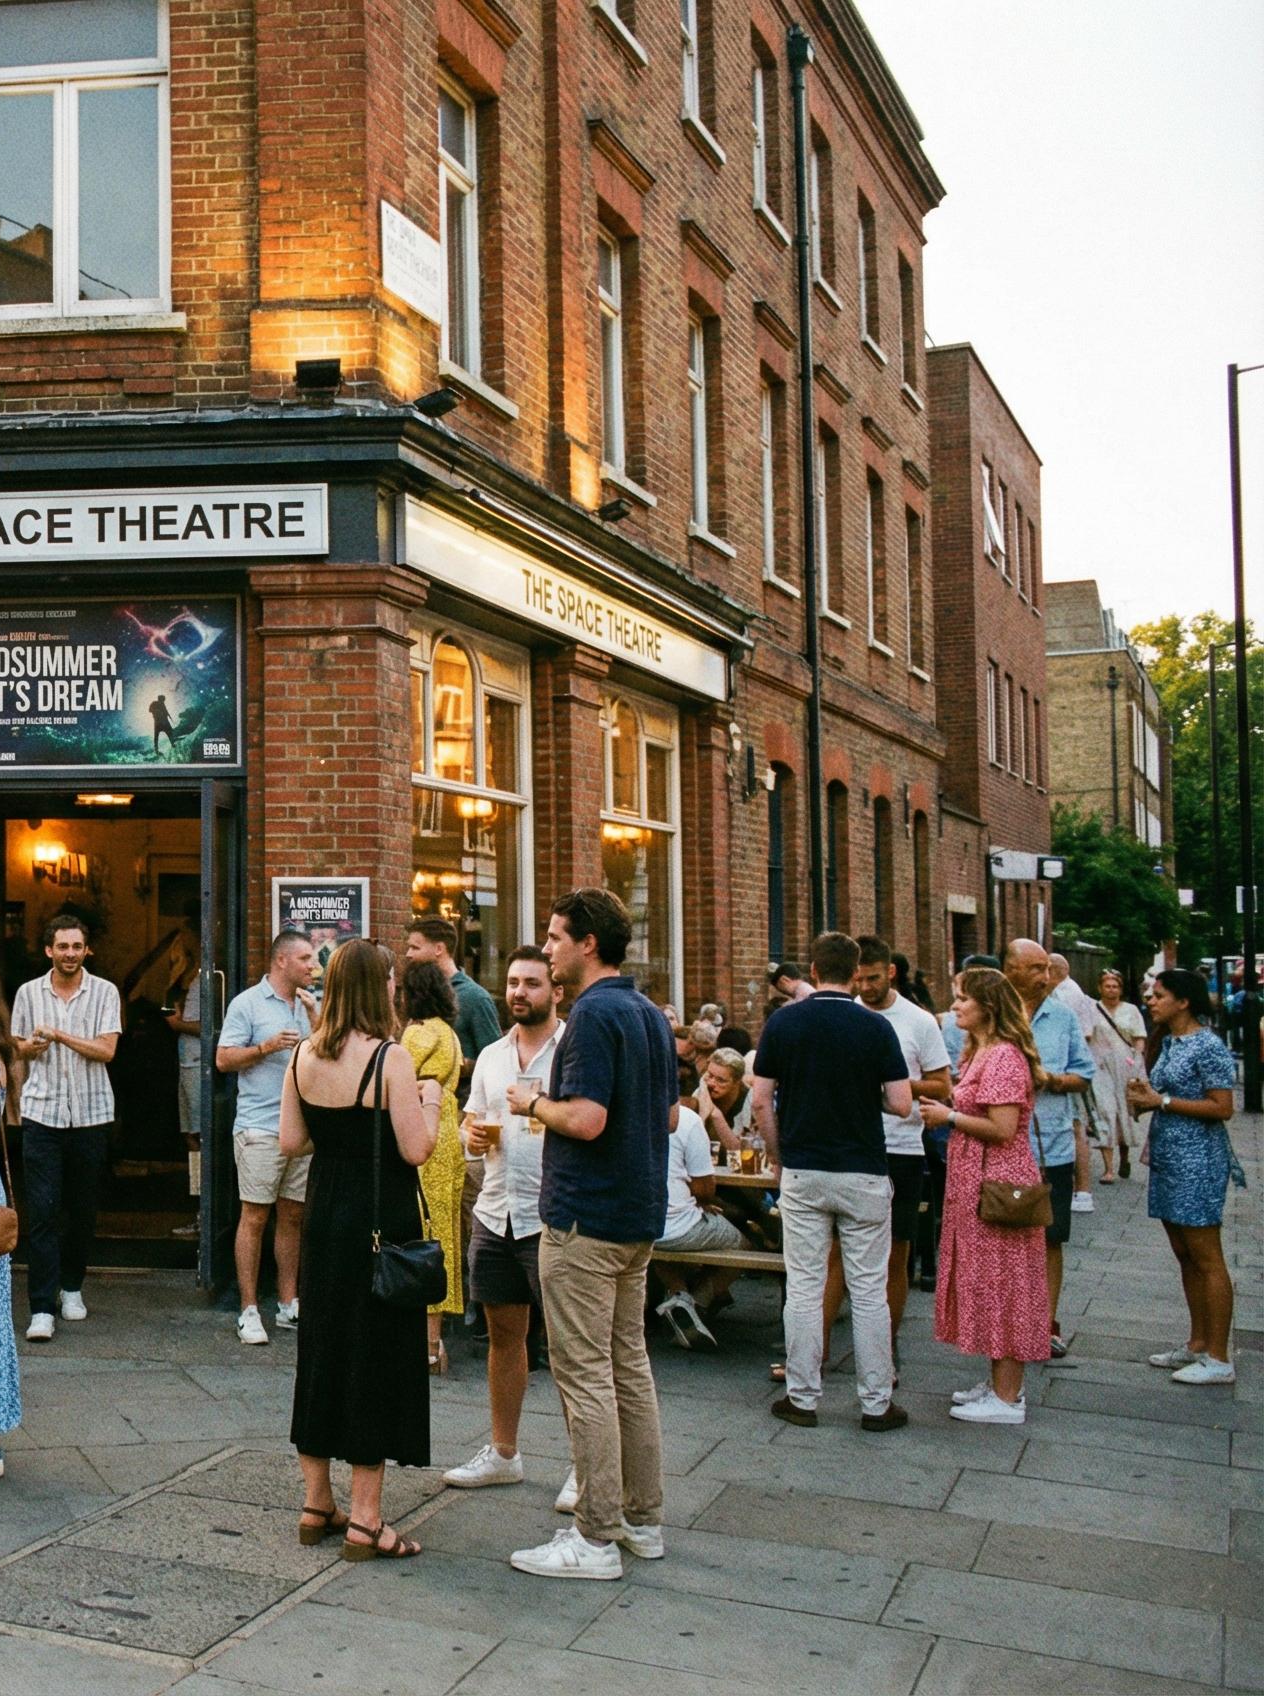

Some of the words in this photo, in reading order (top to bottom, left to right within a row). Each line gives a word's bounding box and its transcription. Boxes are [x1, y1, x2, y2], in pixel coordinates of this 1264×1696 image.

[88, 501, 305, 543] THEATRE
[522, 568, 553, 615] THE
[557, 585, 602, 638] SPACE
[606, 609, 662, 663] THEATRE
[37, 680, 123, 712] DREAM
